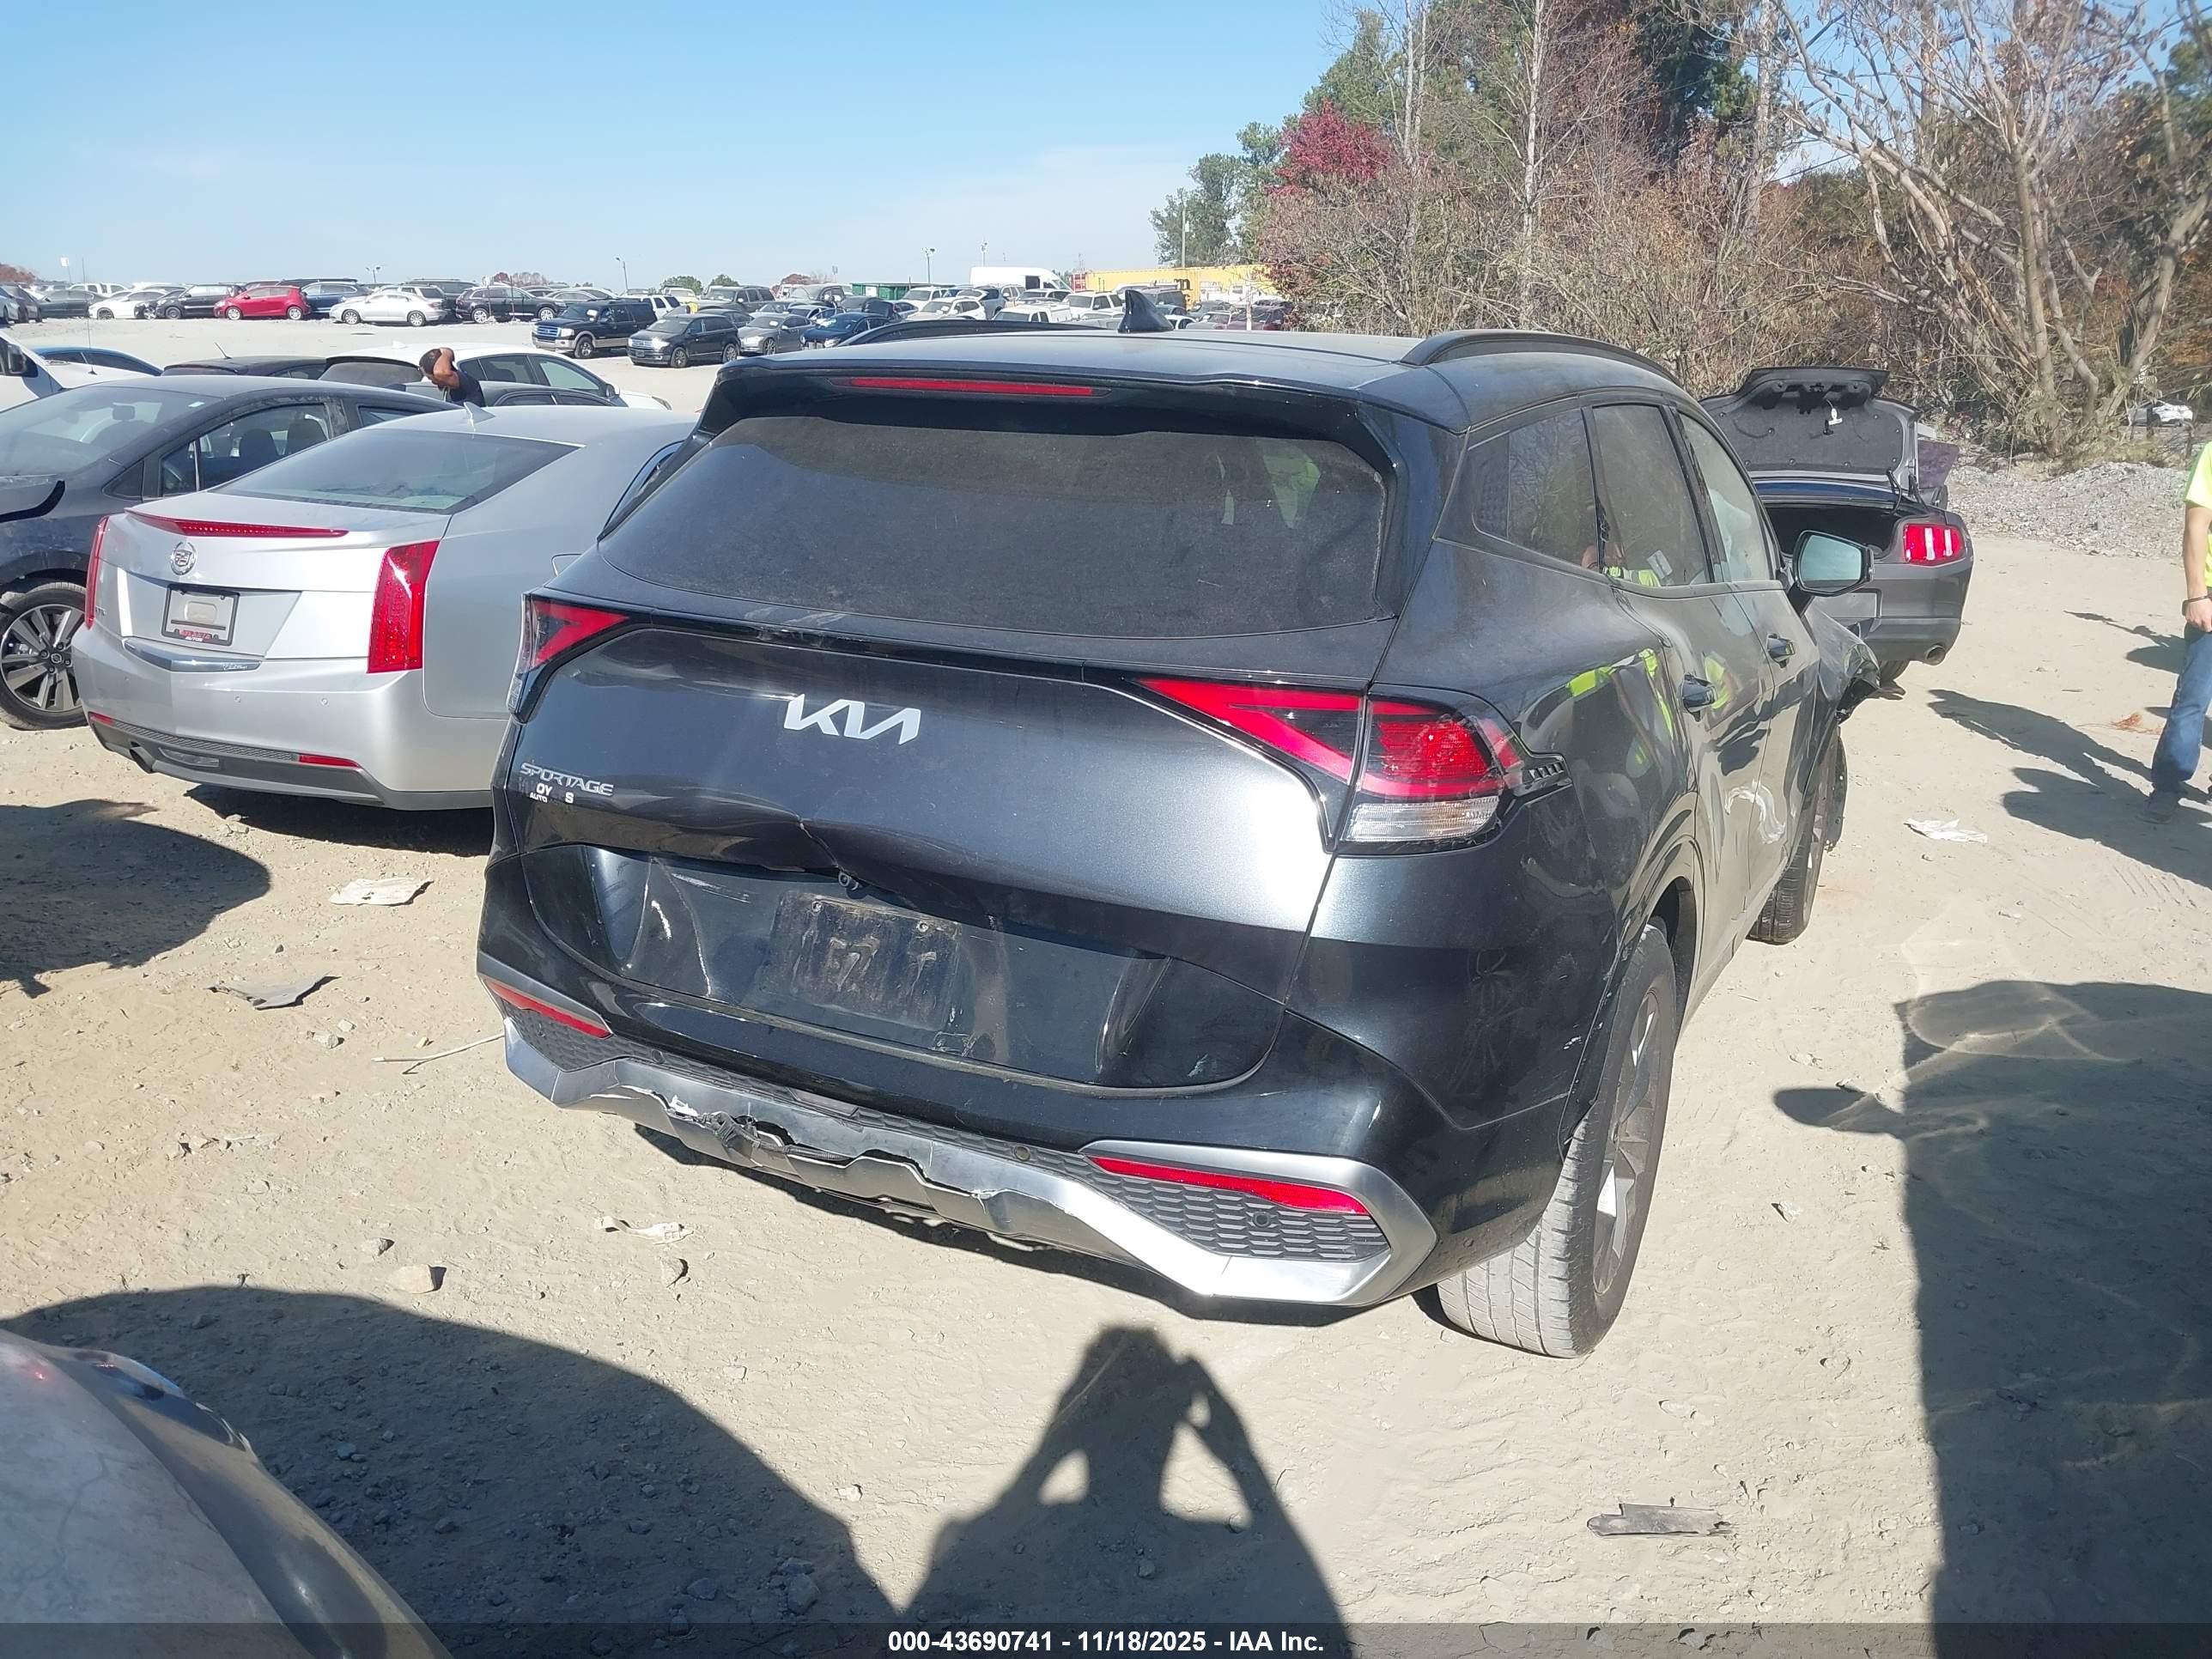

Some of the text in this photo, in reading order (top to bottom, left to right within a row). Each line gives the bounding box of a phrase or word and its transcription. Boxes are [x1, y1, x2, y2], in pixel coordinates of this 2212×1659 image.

[784, 694, 921, 744] KIA
[520, 763, 614, 796] SPORTAGE
[529, 792, 548, 804] AUTO
